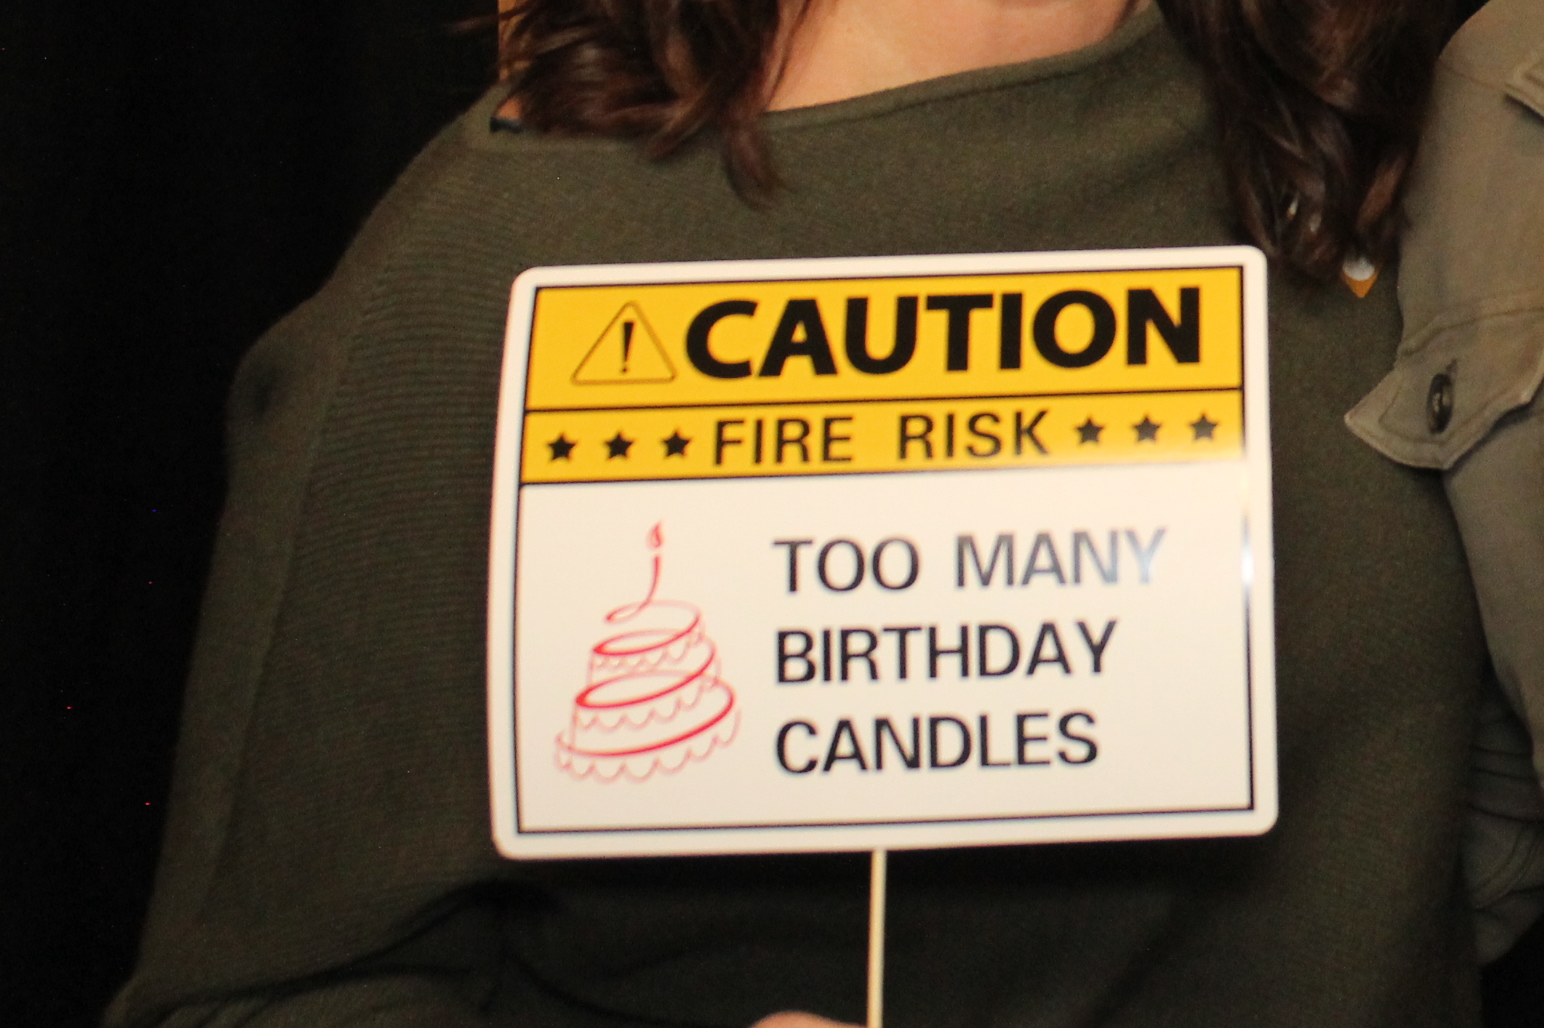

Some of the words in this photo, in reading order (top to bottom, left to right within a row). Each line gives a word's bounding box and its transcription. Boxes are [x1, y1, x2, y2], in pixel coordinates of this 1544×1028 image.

[684, 286, 1201, 379] CAUTION
[714, 416, 855, 467] FIRE
[898, 410, 1051, 460] RISK
[773, 537, 920, 595] TOO
[955, 527, 1168, 590] MANY
[775, 619, 1118, 686] BIRTHDAY
[775, 710, 1099, 775] CANDLES
